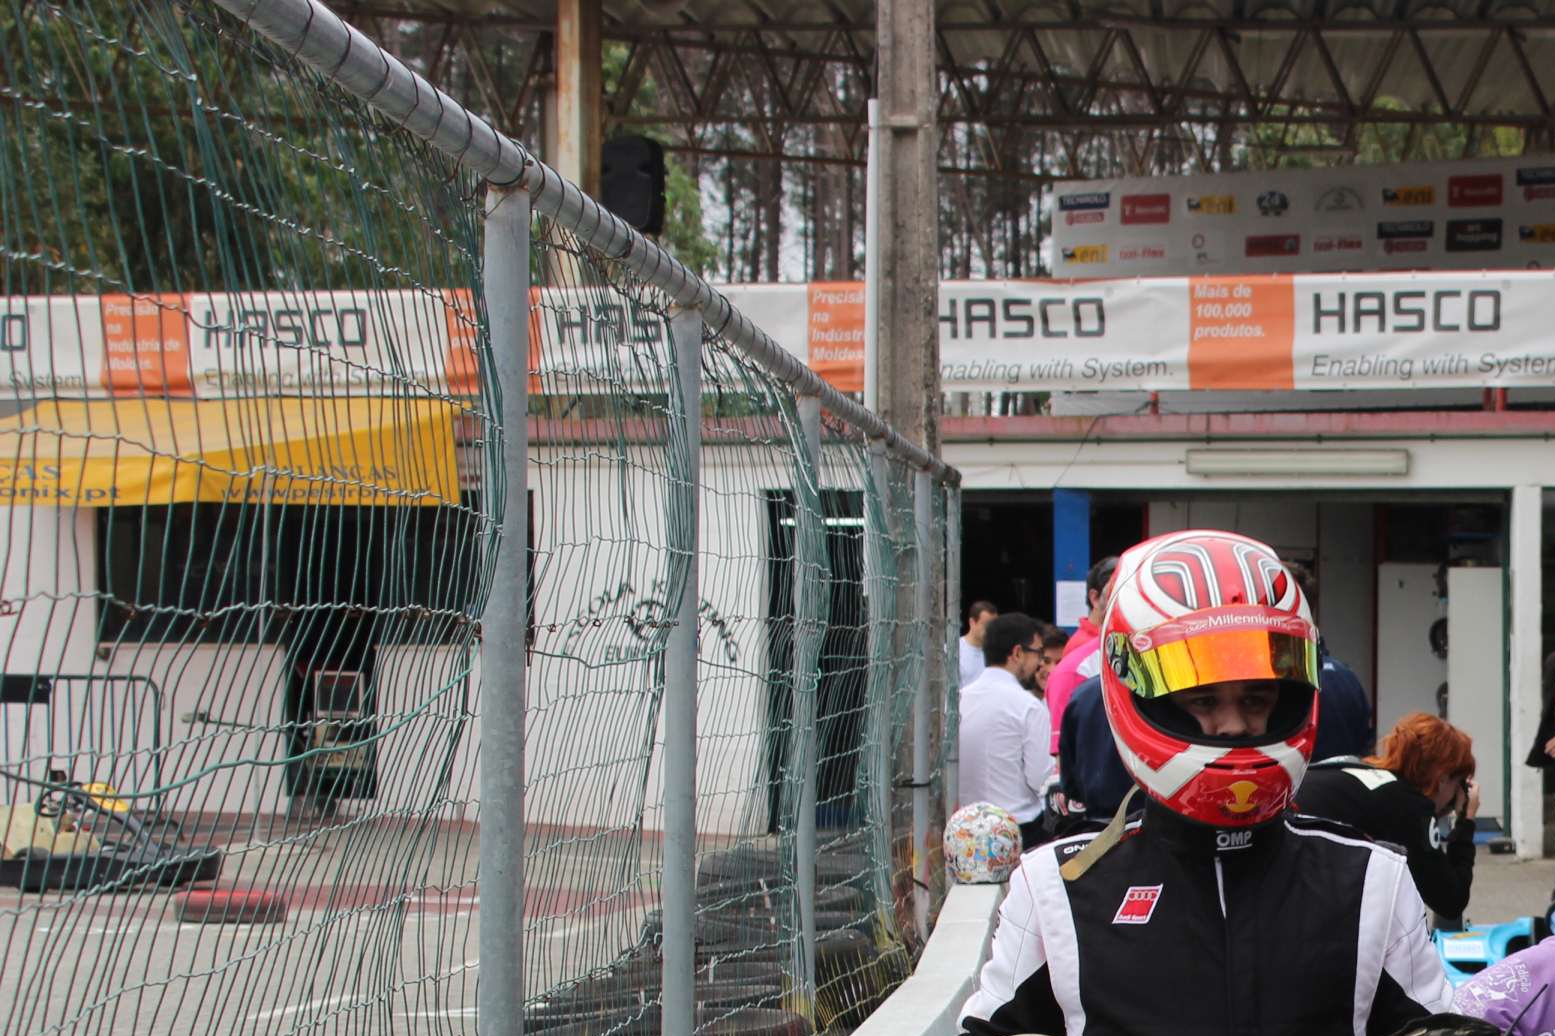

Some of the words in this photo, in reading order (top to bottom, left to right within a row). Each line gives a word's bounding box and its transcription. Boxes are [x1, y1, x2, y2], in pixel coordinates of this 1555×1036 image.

[1195, 285, 1228, 299] Mais
[1235, 285, 1252, 298] de
[938, 298, 1106, 340] HASCO
[1195, 304, 1252, 318] 100,000
[1312, 290, 1501, 334] HASCO
[204, 308, 367, 348] HASCO
[557, 303, 662, 345] HAS
[1194, 324, 1265, 341] produtos.
[940, 359, 1020, 382] nabling
[1029, 358, 1073, 379] with
[1081, 358, 1174, 381] System.
[1311, 355, 1413, 379] Enabling
[1422, 354, 1468, 375] with
[1208, 613, 1283, 629] Millennium
[1063, 844, 1090, 854] ON
[1216, 831, 1253, 848] OMP
